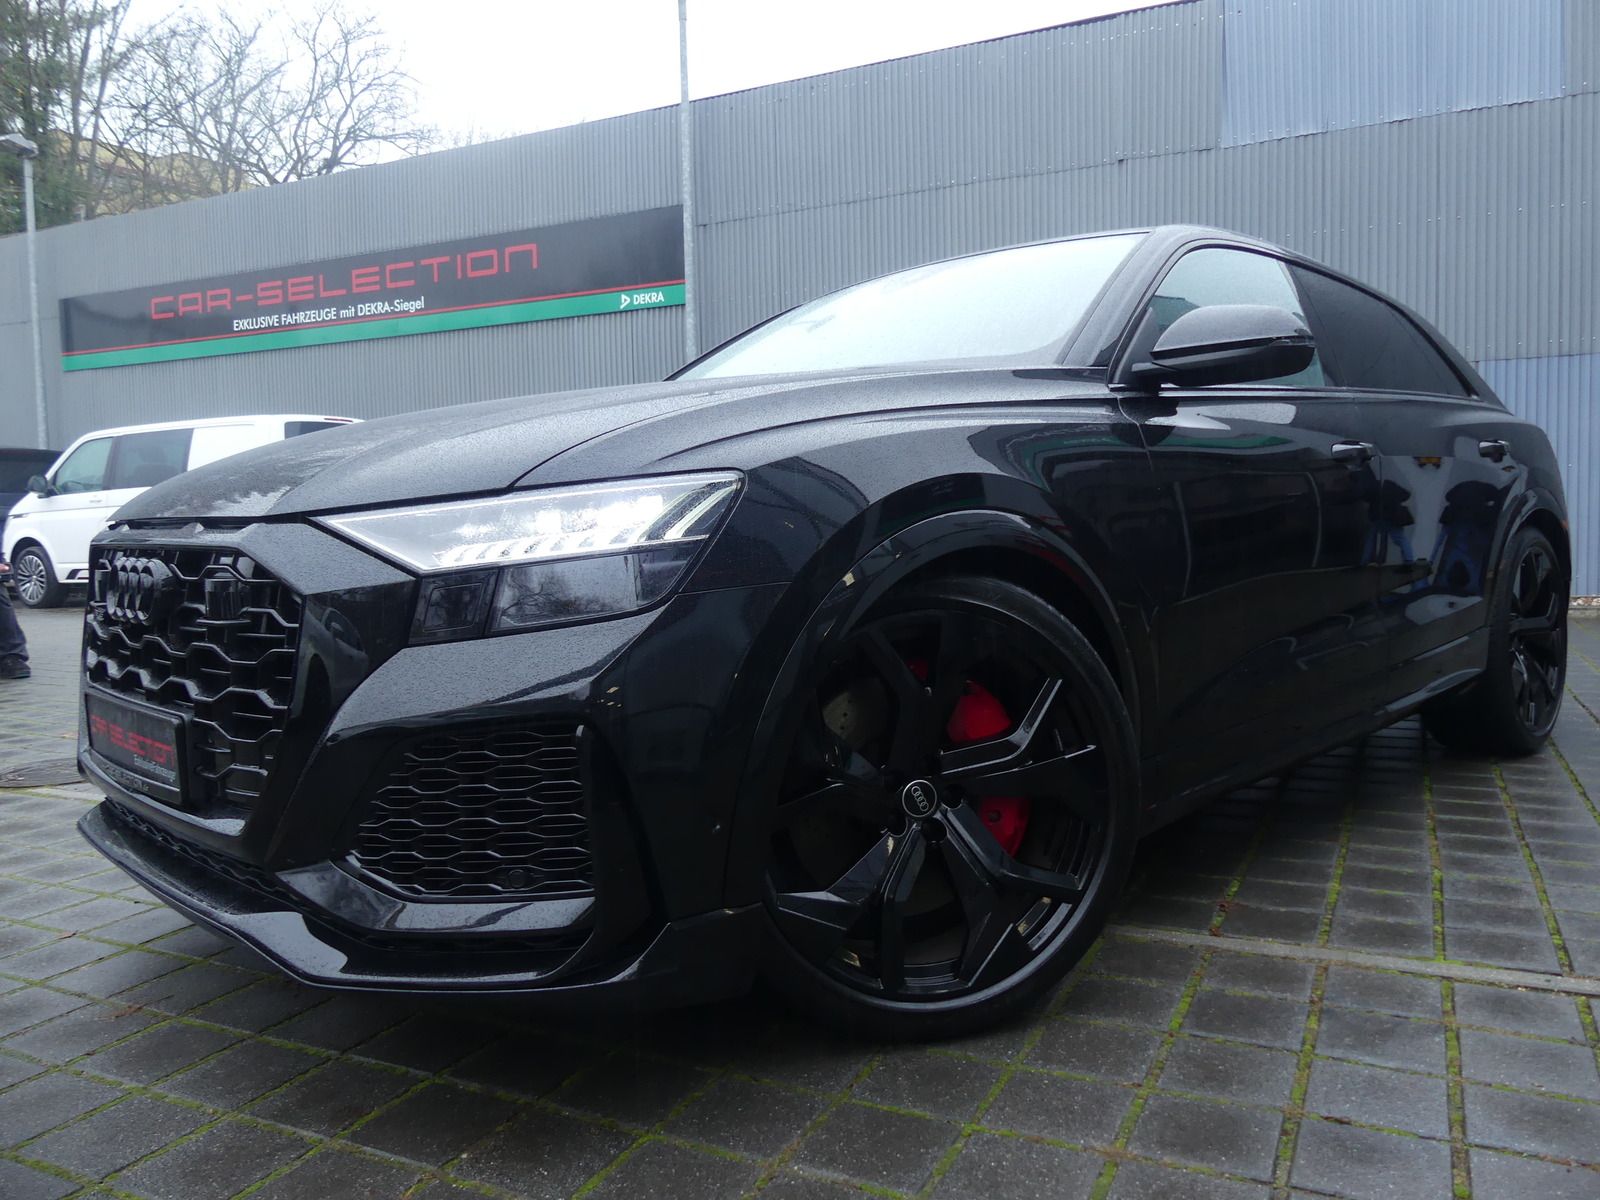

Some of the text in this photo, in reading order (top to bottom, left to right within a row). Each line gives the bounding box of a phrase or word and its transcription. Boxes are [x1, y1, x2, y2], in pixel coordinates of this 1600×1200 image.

[150, 243, 539, 321] CAR-SELECTION
[632, 290, 665, 305] DEKRA
[232, 295, 425, 332] EXKLUSIVE FAHRZEUGE mit DEKRA-Siegel
